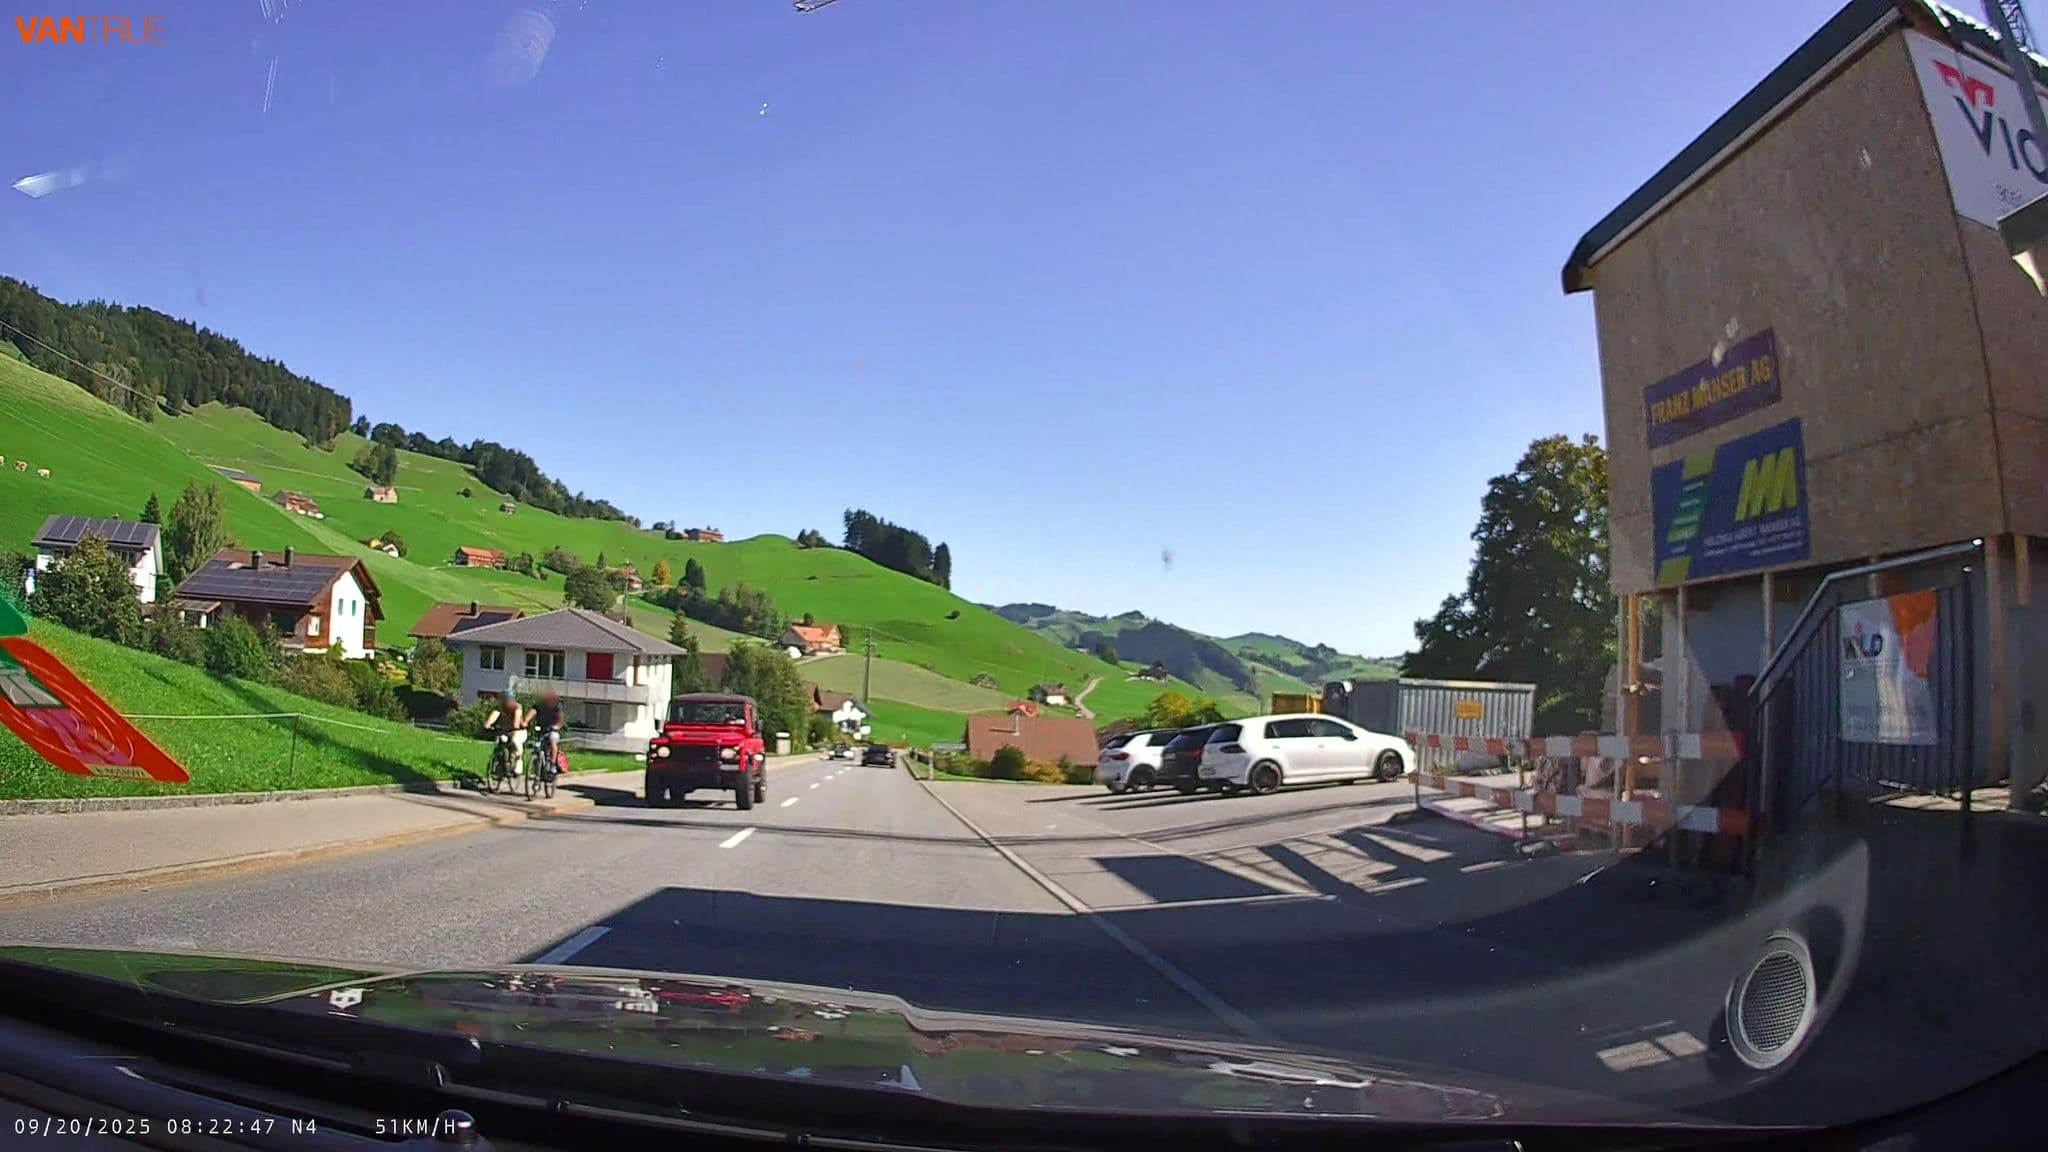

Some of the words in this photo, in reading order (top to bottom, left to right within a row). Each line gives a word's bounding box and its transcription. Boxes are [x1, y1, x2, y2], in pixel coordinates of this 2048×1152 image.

[1652, 388, 1690, 425] FRANZ
[1692, 365, 1746, 409] MANSER
[1750, 355, 1772, 386] AG
